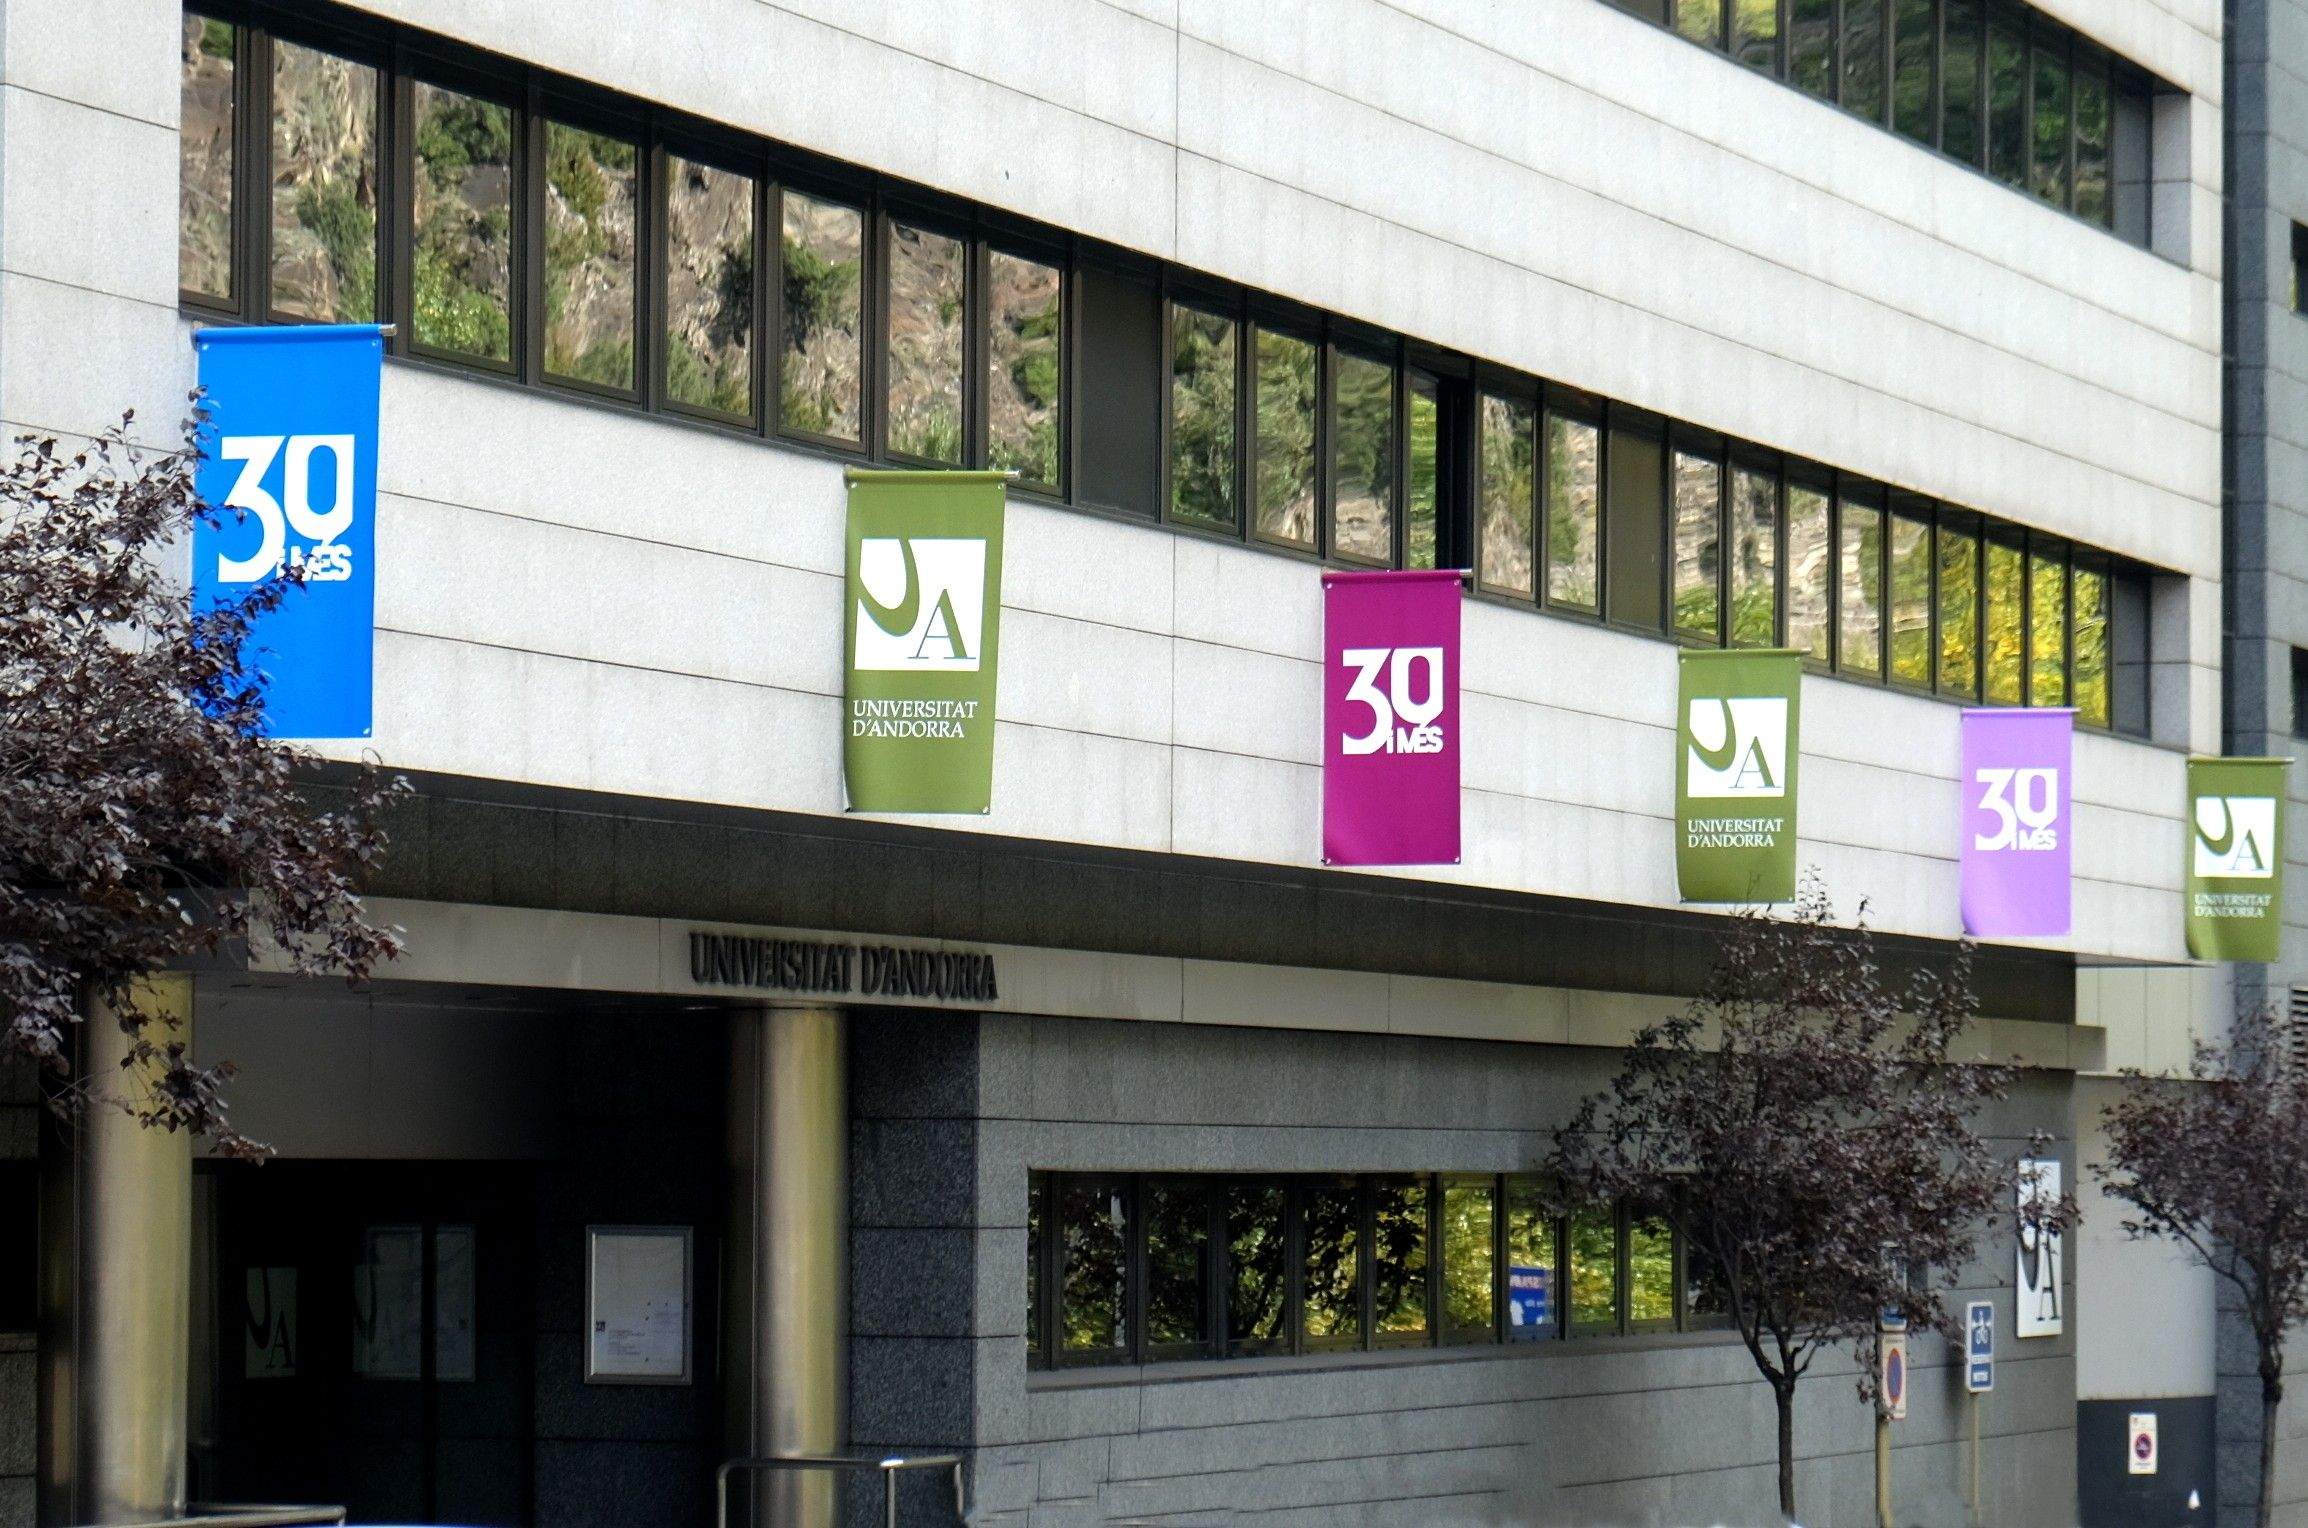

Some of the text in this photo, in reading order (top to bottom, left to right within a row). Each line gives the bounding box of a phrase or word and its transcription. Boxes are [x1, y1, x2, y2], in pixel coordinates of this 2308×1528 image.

[217, 434, 355, 582] 30
[853, 699, 978, 718] UNIVERSITAT
[1342, 647, 1444, 754] 30
[852, 719, 965, 738] D'ANDORRA
[1687, 818, 1784, 833] UNIVERSITAT
[1975, 768, 2058, 850] 30
[1687, 833, 1775, 848] D'ANDORRA
[689, 932, 998, 1002] UNIVERSITAT D'ANDORRA
